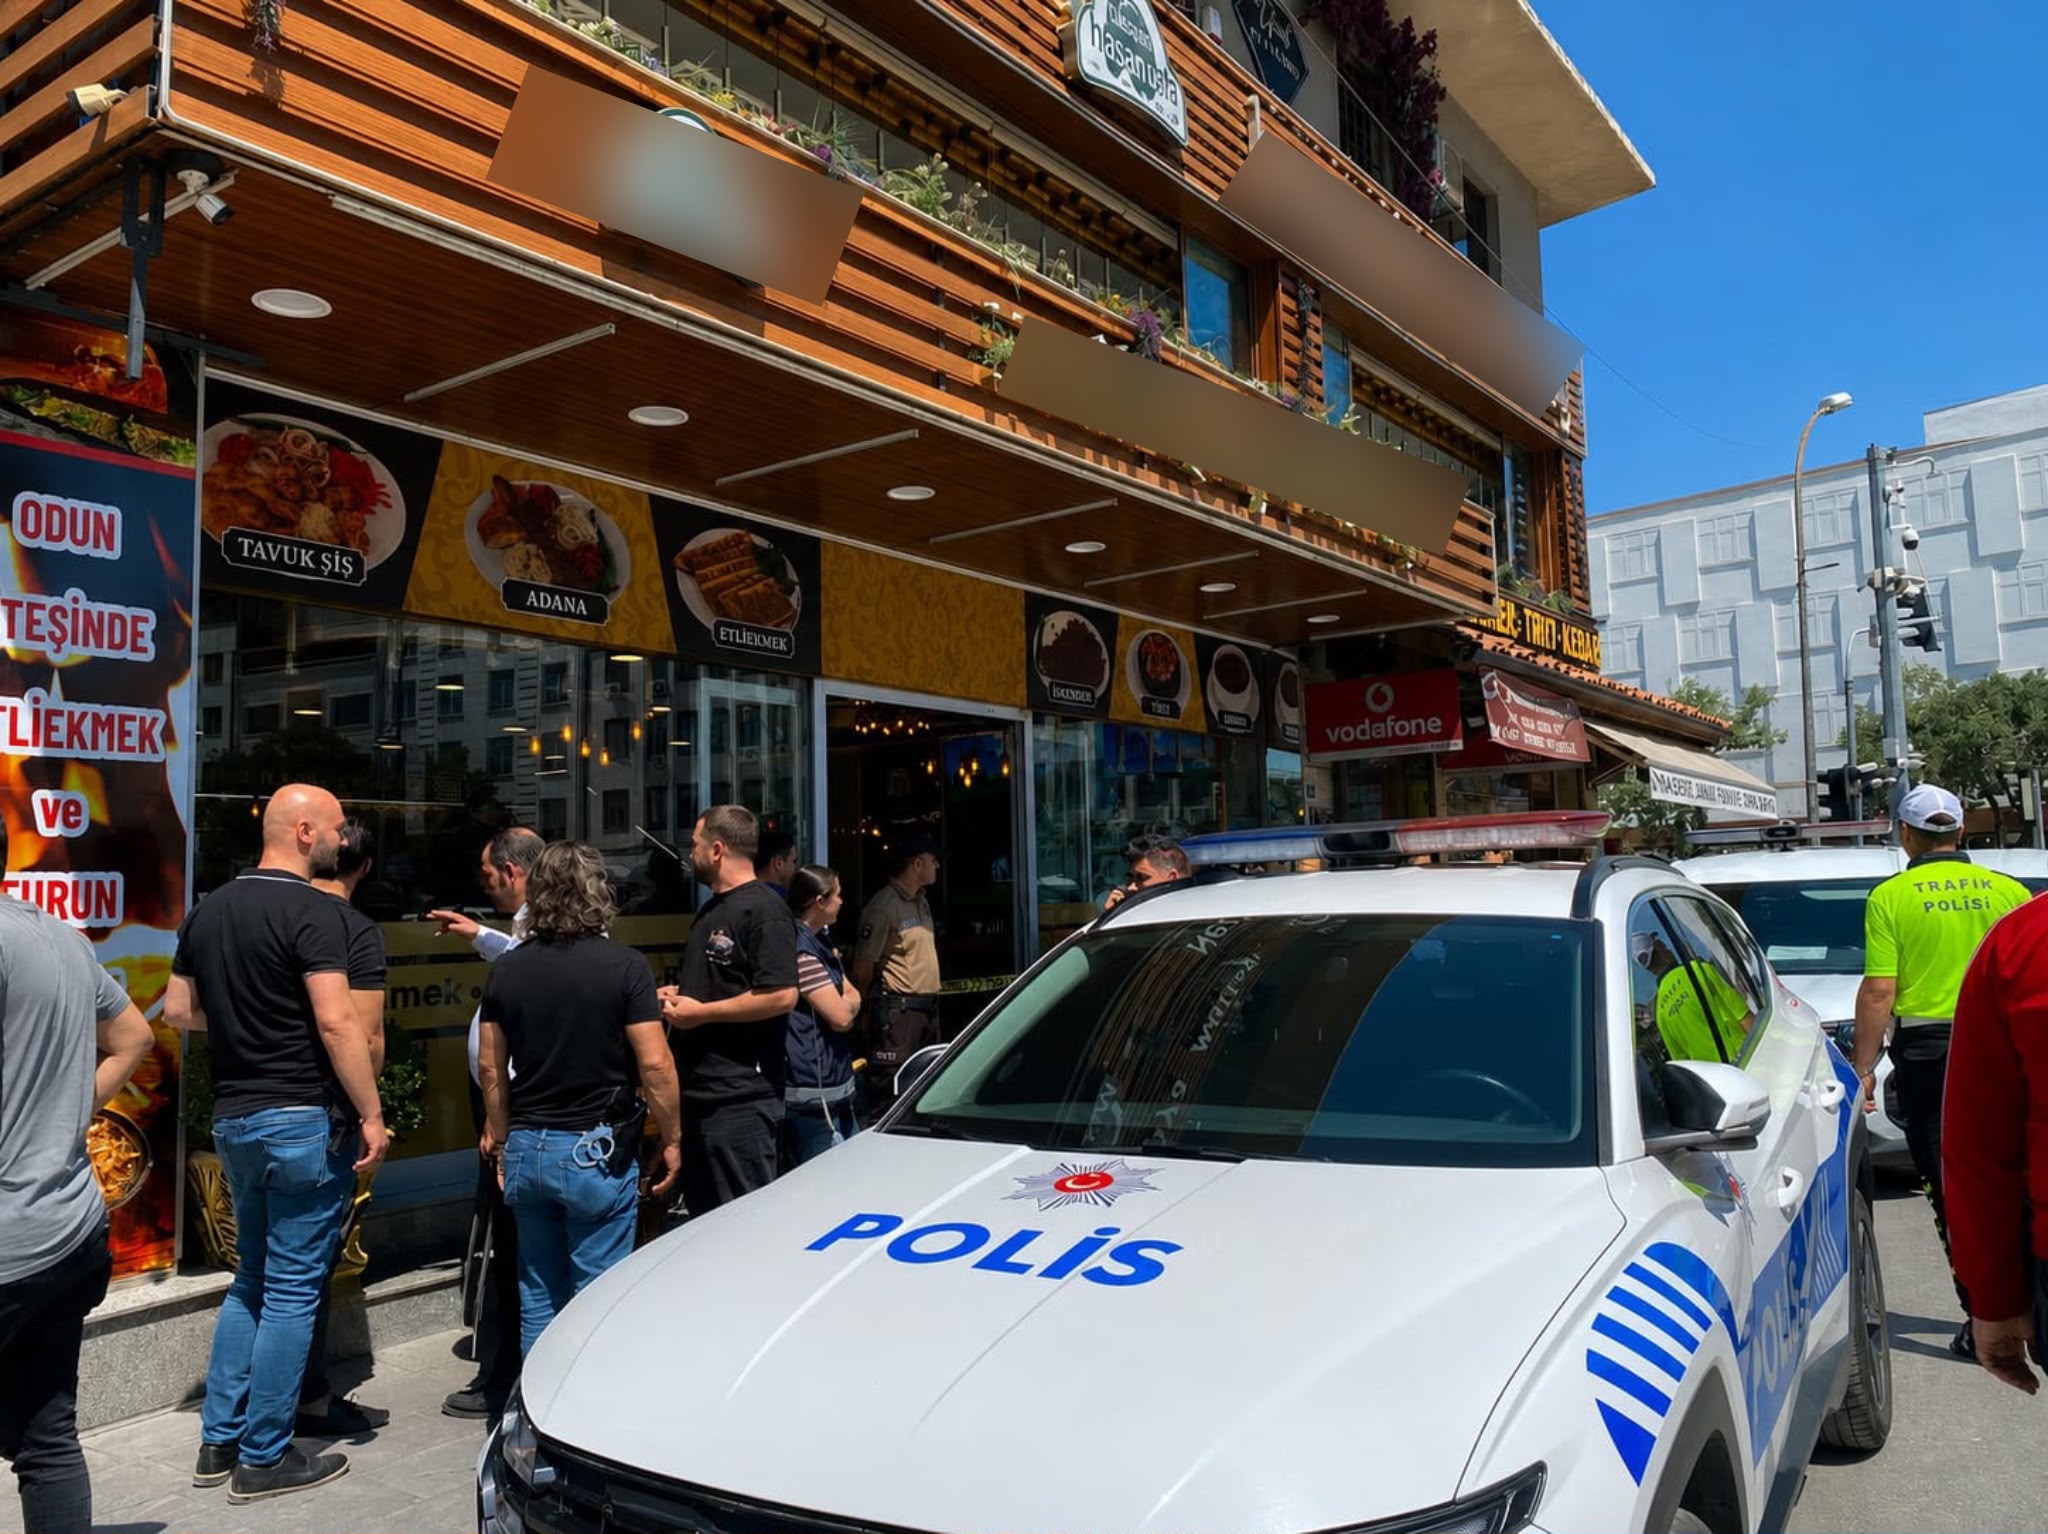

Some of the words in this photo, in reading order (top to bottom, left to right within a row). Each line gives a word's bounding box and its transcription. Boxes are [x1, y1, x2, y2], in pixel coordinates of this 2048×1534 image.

[20, 499, 116, 552] ODUN
[238, 537, 316, 569] TAVUK
[320, 550, 354, 579] ŞİŞ
[526, 589, 588, 616] ADANA
[0, 695, 161, 755] LİEKMEK
[1325, 715, 1443, 744] vodafone
[39, 797, 84, 830] ve
[1923, 895, 1992, 914] POLİSİ
[803, 1212, 1185, 1287] POLİS
